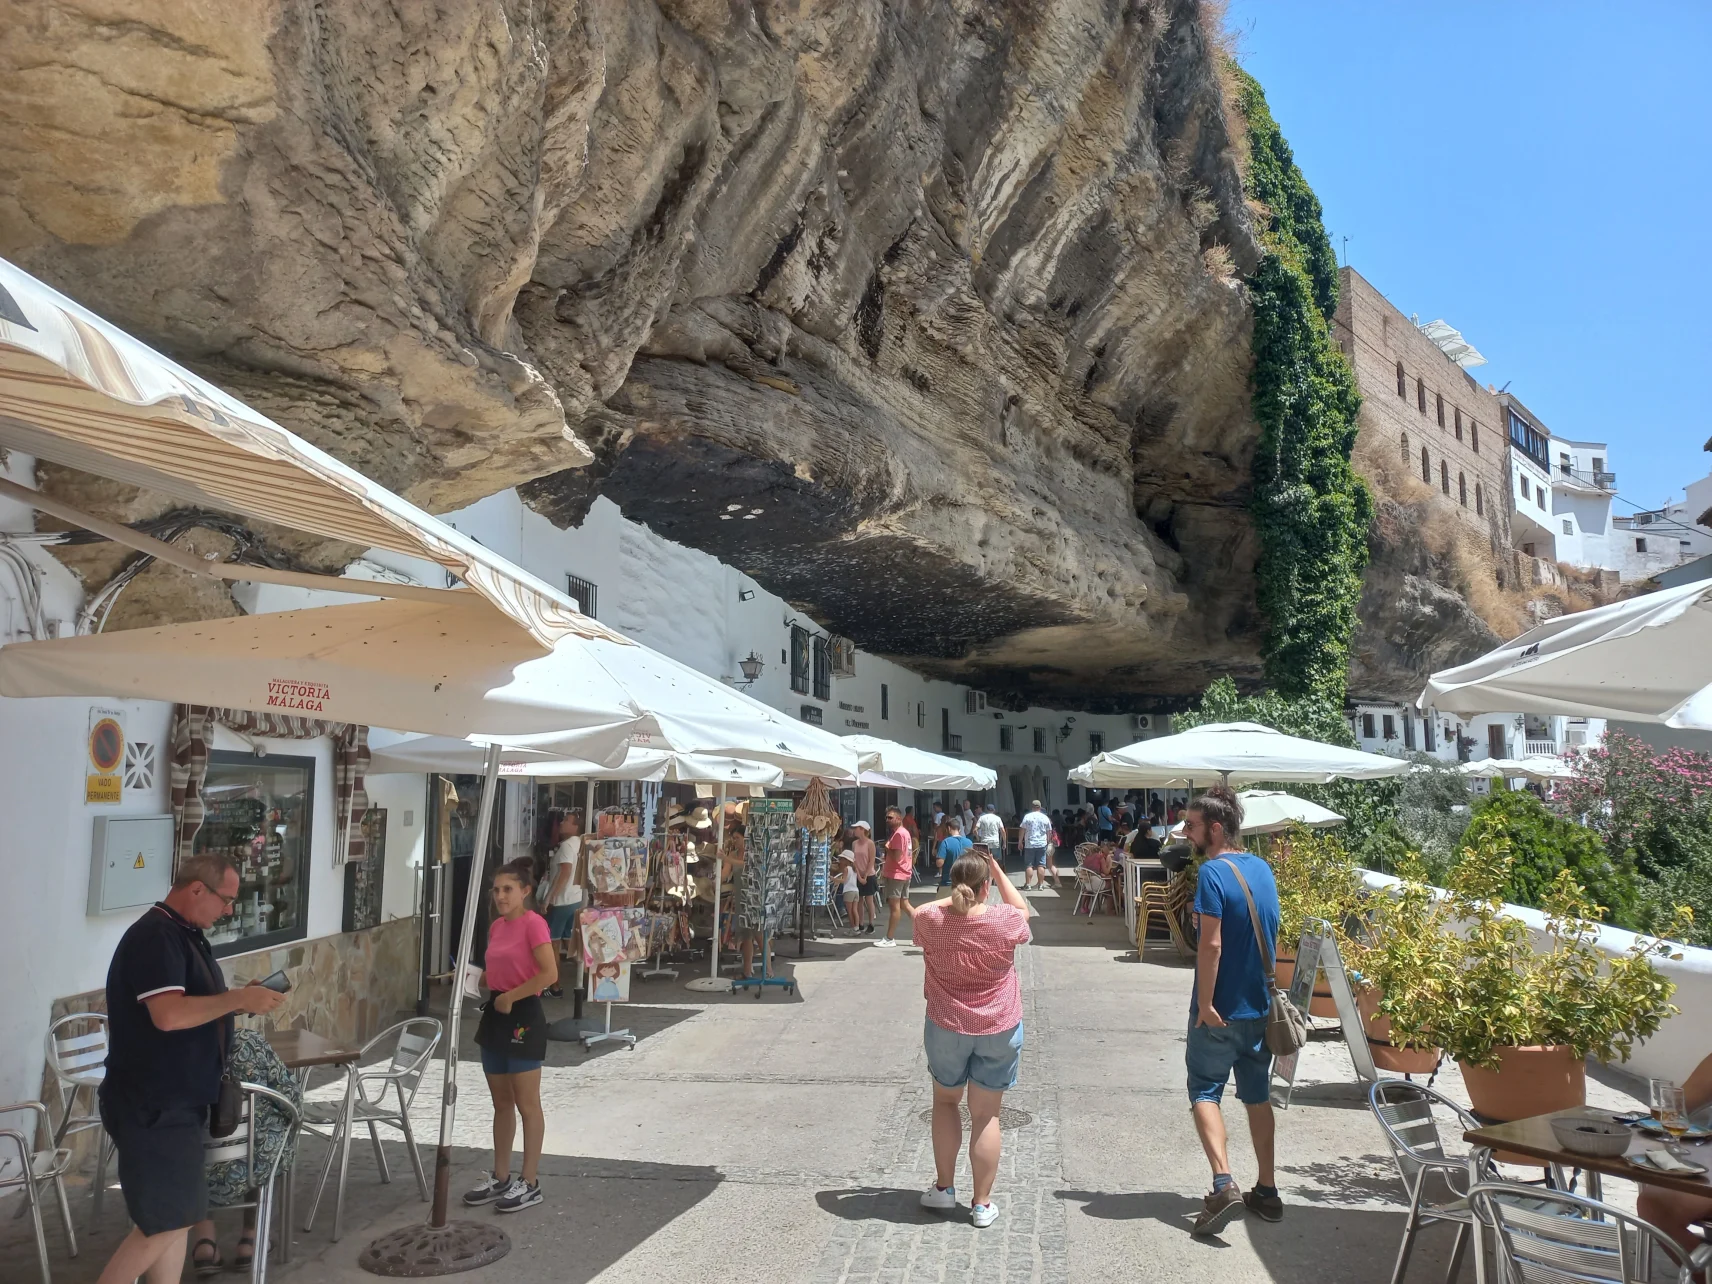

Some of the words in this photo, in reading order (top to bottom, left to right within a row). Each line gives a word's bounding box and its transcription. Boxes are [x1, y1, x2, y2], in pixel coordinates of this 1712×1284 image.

[267, 682, 331, 700] VICTORIA
[266, 695, 323, 712] MÁLAGA
[97, 778, 112, 787] VADO
[87, 791, 120, 800] PERMANENTE
